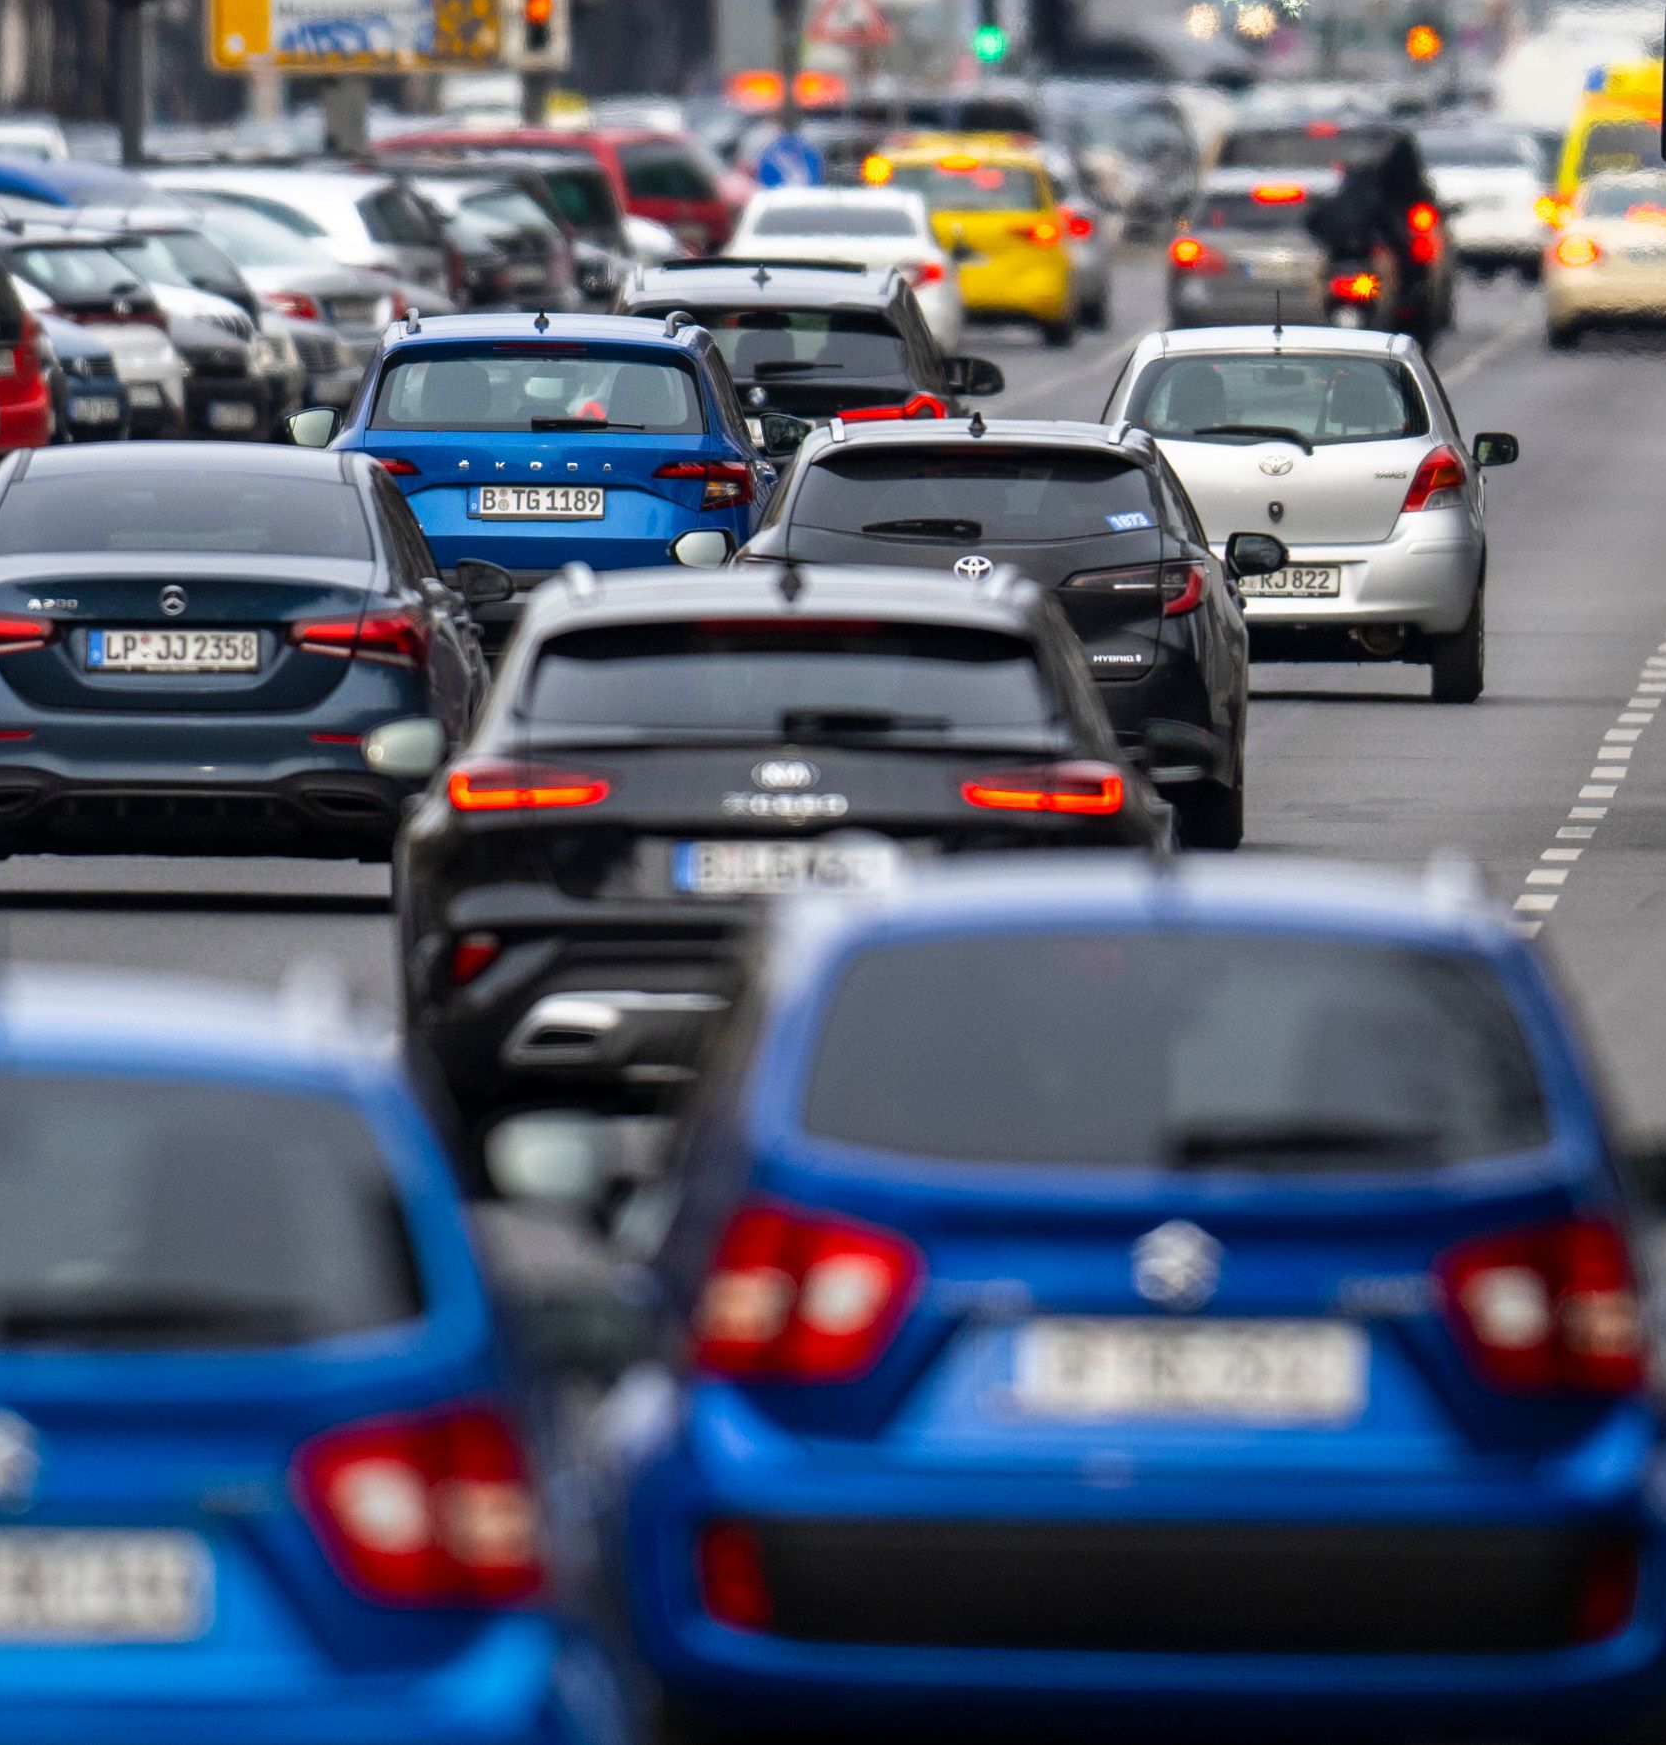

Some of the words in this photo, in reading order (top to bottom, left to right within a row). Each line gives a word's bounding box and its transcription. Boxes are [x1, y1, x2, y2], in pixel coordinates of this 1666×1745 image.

[483, 489, 496, 510] B
[512, 489, 540, 511] TG
[546, 490, 601, 512] 1189
[1292, 570, 1330, 590] 822
[106, 637, 136, 660] LP
[157, 637, 187, 660] JJ
[194, 637, 254, 661] 2358
